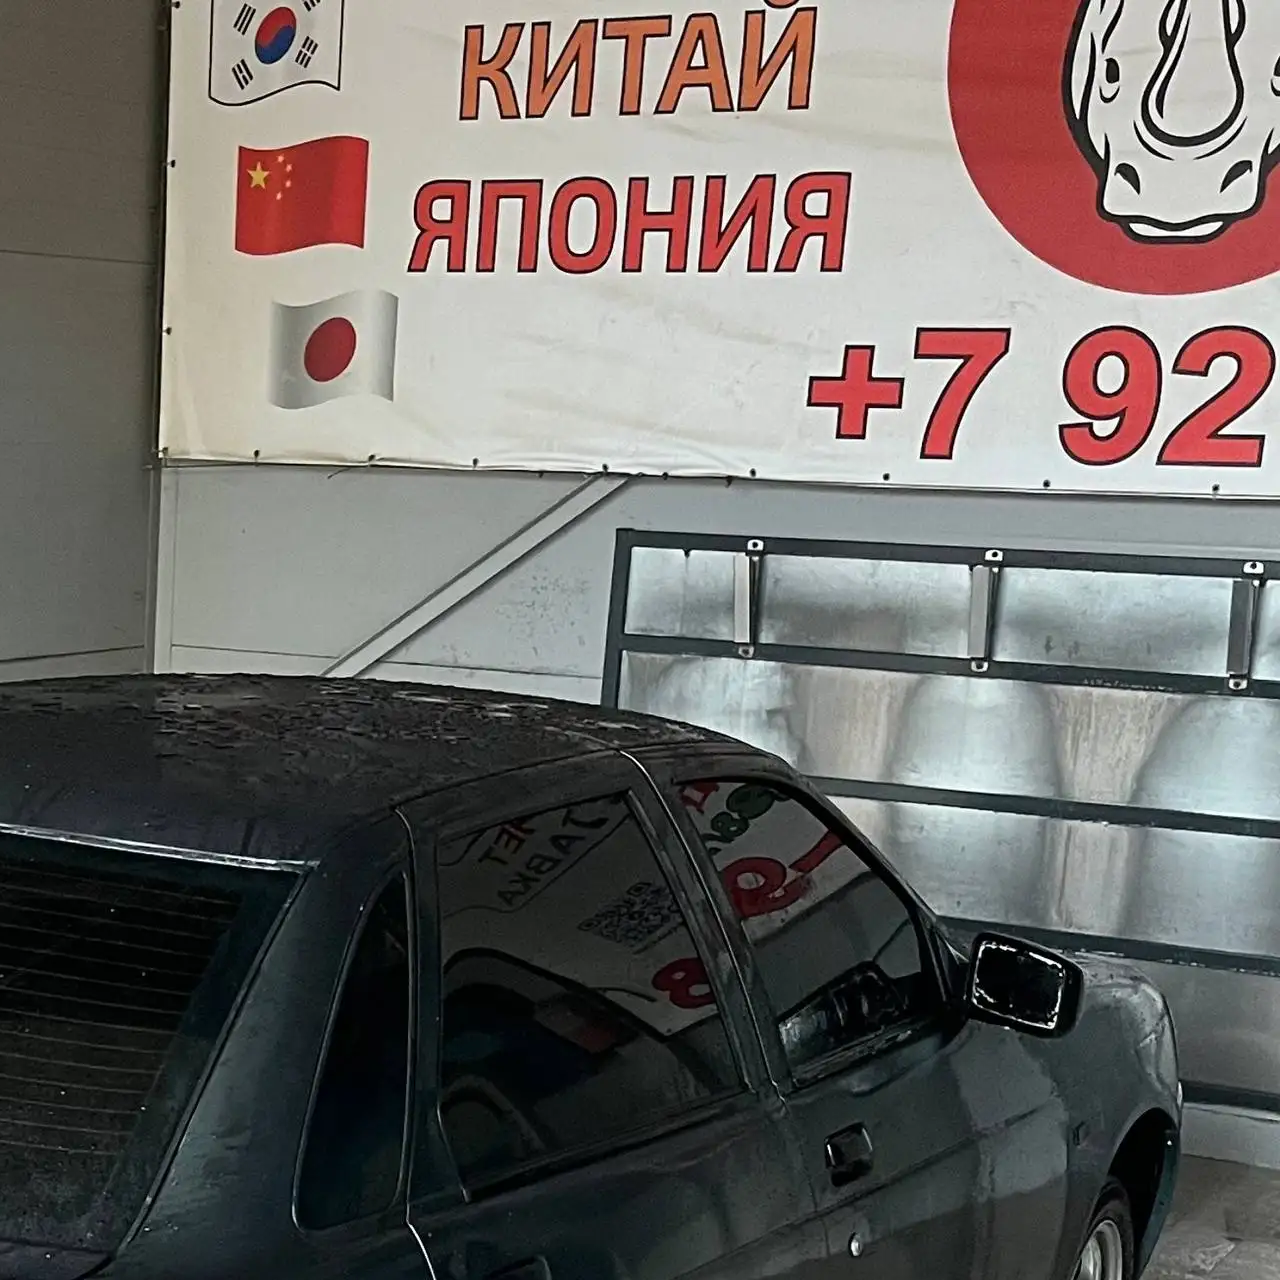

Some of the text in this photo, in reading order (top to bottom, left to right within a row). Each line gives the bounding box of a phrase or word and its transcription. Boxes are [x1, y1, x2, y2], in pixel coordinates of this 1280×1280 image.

[458, 0, 818, 121] КИТАЙ
[406, 171, 852, 274] ЯПОНИЯ
[806, 325, 1277, 467] +7 92
